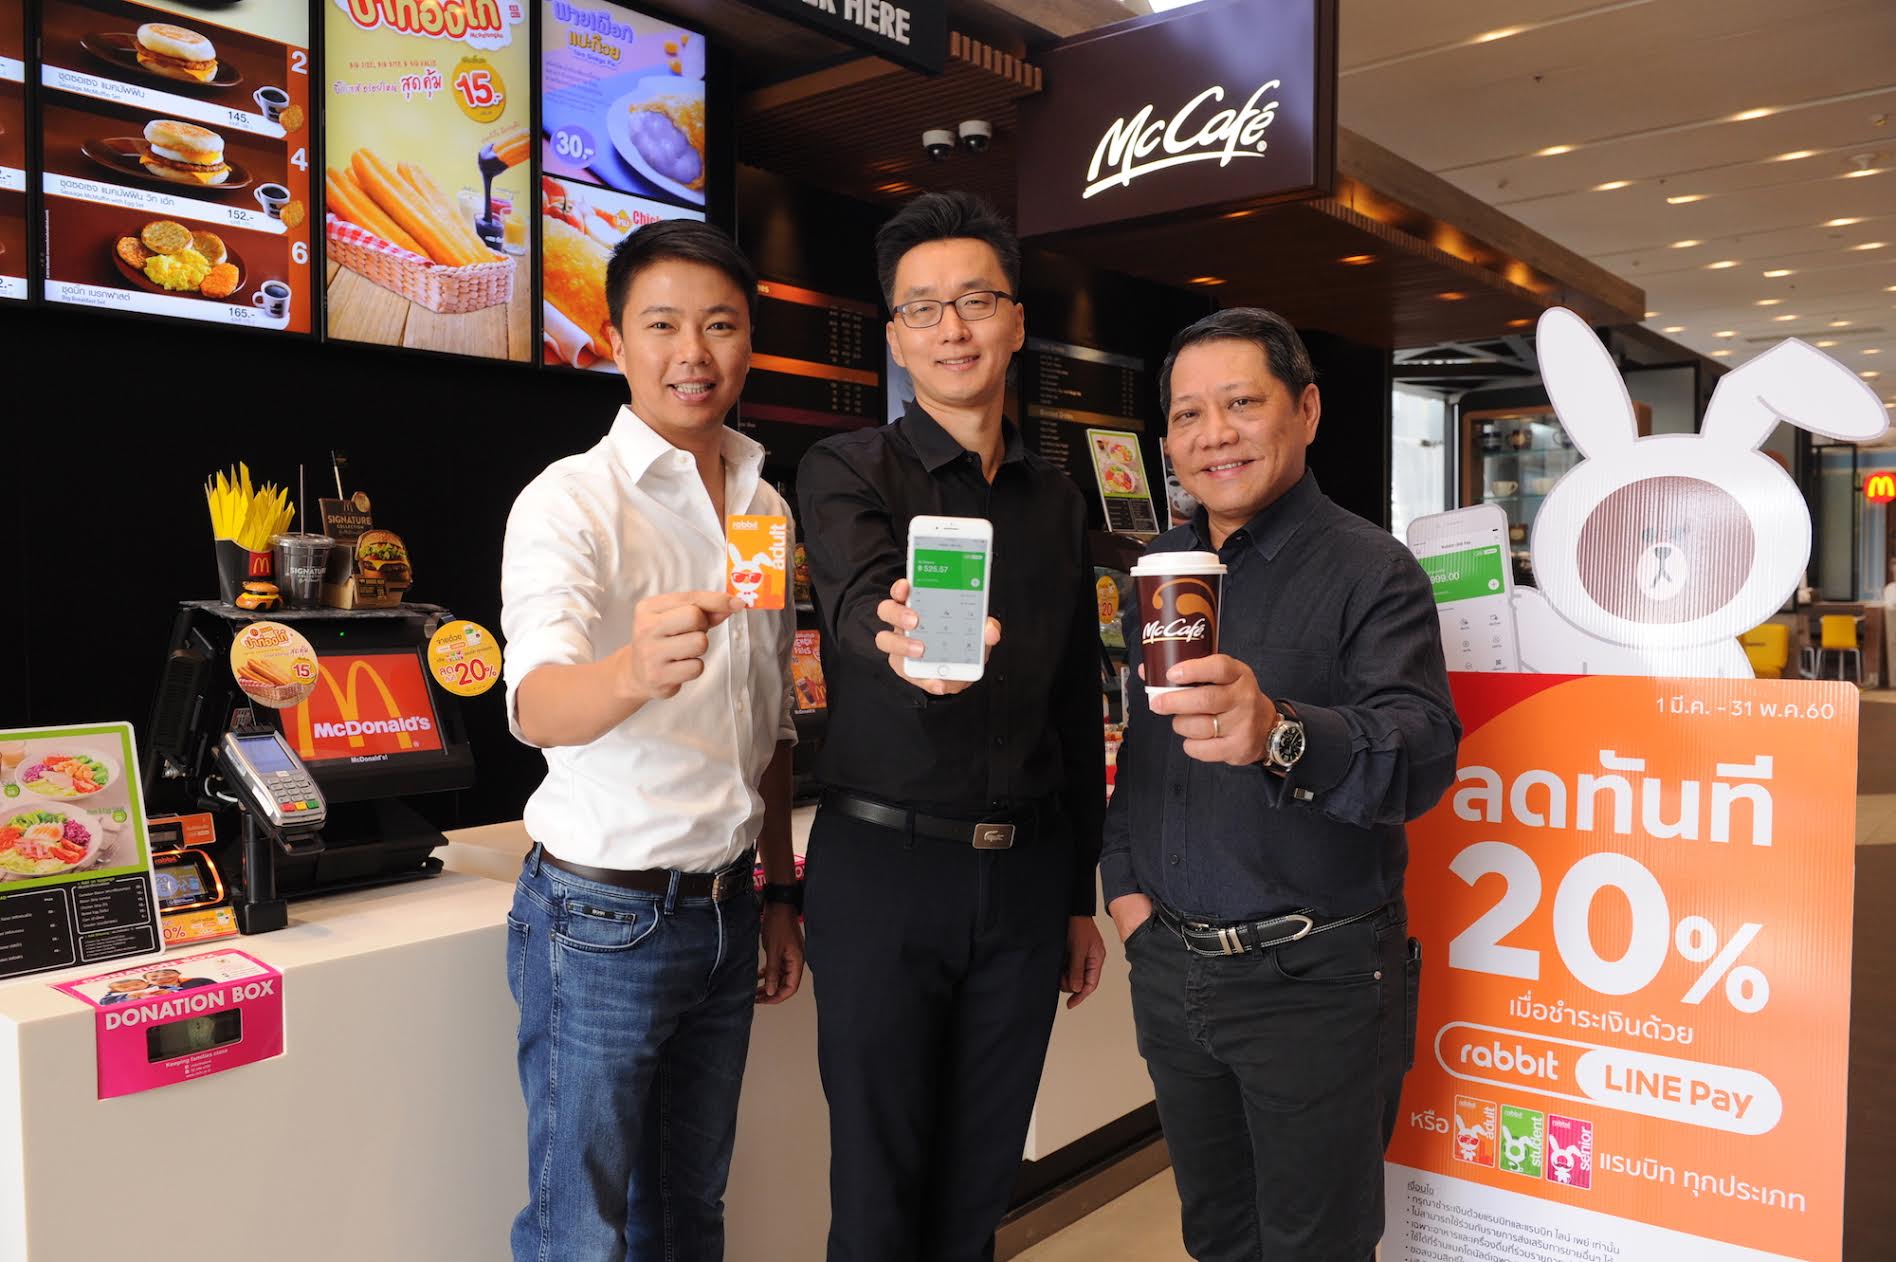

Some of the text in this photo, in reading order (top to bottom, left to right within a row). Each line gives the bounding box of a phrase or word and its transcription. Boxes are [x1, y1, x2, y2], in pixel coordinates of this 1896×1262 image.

[844, 0, 910, 46] HERE
[291, 50, 308, 75] 2
[1084, 80, 1281, 194] McCafé
[290, 148, 308, 172] 4
[228, 209, 254, 221] 152.-
[291, 241, 309, 265] 6
[229, 307, 255, 318] 165.-
[328, 514, 372, 525] SIGNATURE
[768, 523, 786, 571] adult
[1142, 617, 1206, 643] McCafé
[454, 658, 497, 686] 20%
[1656, 697, 1664, 713] 1
[1670, 695, 1711, 715] มี.ค.
[1731, 700, 1752, 716] 31
[1759, 703, 1835, 720] พ.ค.60
[313, 716, 432, 739] McDonald's
[1452, 750, 1774, 847] ลดทันที
[163, 926, 186, 940] 0%
[1448, 840, 1770, 1013] 20%
[105, 978, 274, 1031] DONATION BOX
[1509, 989, 1694, 1045] เมื่อชำระเงินด้วย
[1460, 1042, 1755, 1120] rabbit LINE Pay
[1483, 1106, 1495, 1140] adult
[1531, 1117, 1543, 1167] student
[1579, 1126, 1592, 1171] senior
[1410, 1109, 1807, 1213] หรือ แรบบิท ทุกประเภท
